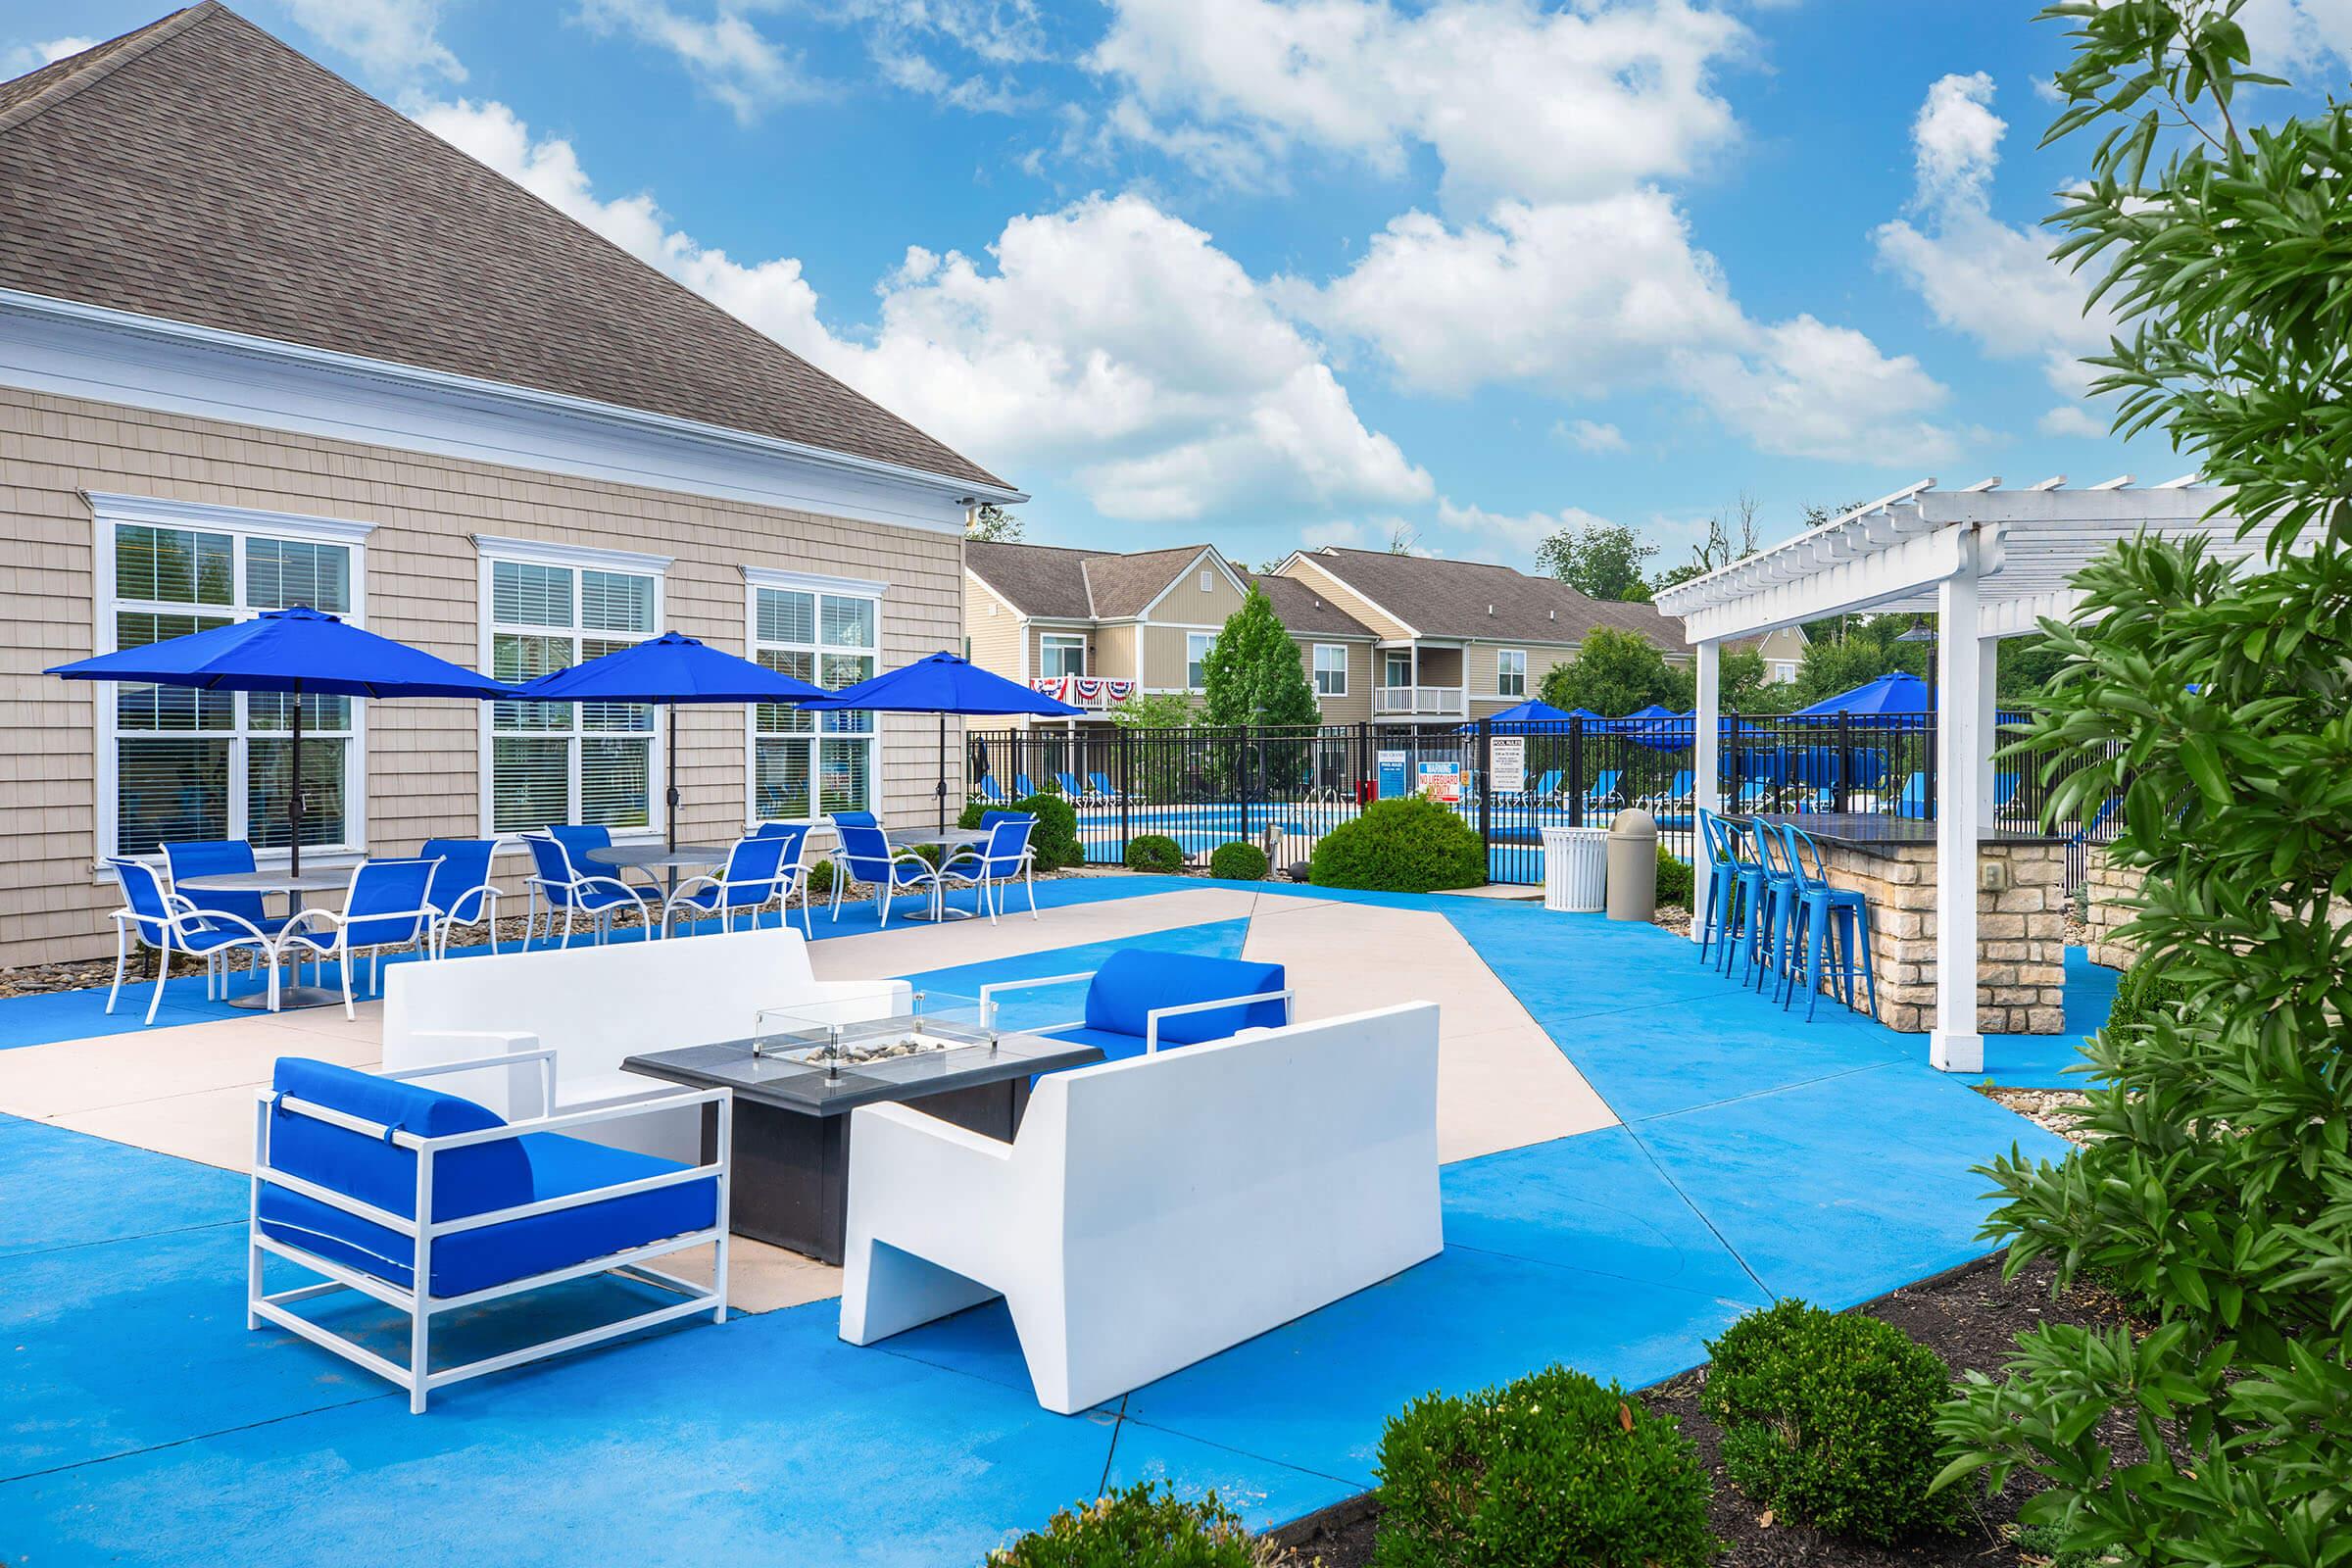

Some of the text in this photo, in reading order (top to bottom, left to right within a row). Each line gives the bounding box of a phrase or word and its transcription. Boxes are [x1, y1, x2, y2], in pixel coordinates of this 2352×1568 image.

[1427, 763, 1451, 773] WARNING
[1420, 775, 1427, 784] NO
[1429, 775, 1458, 784] LIFEGUARD
[1437, 784, 1450, 794] DUTY
